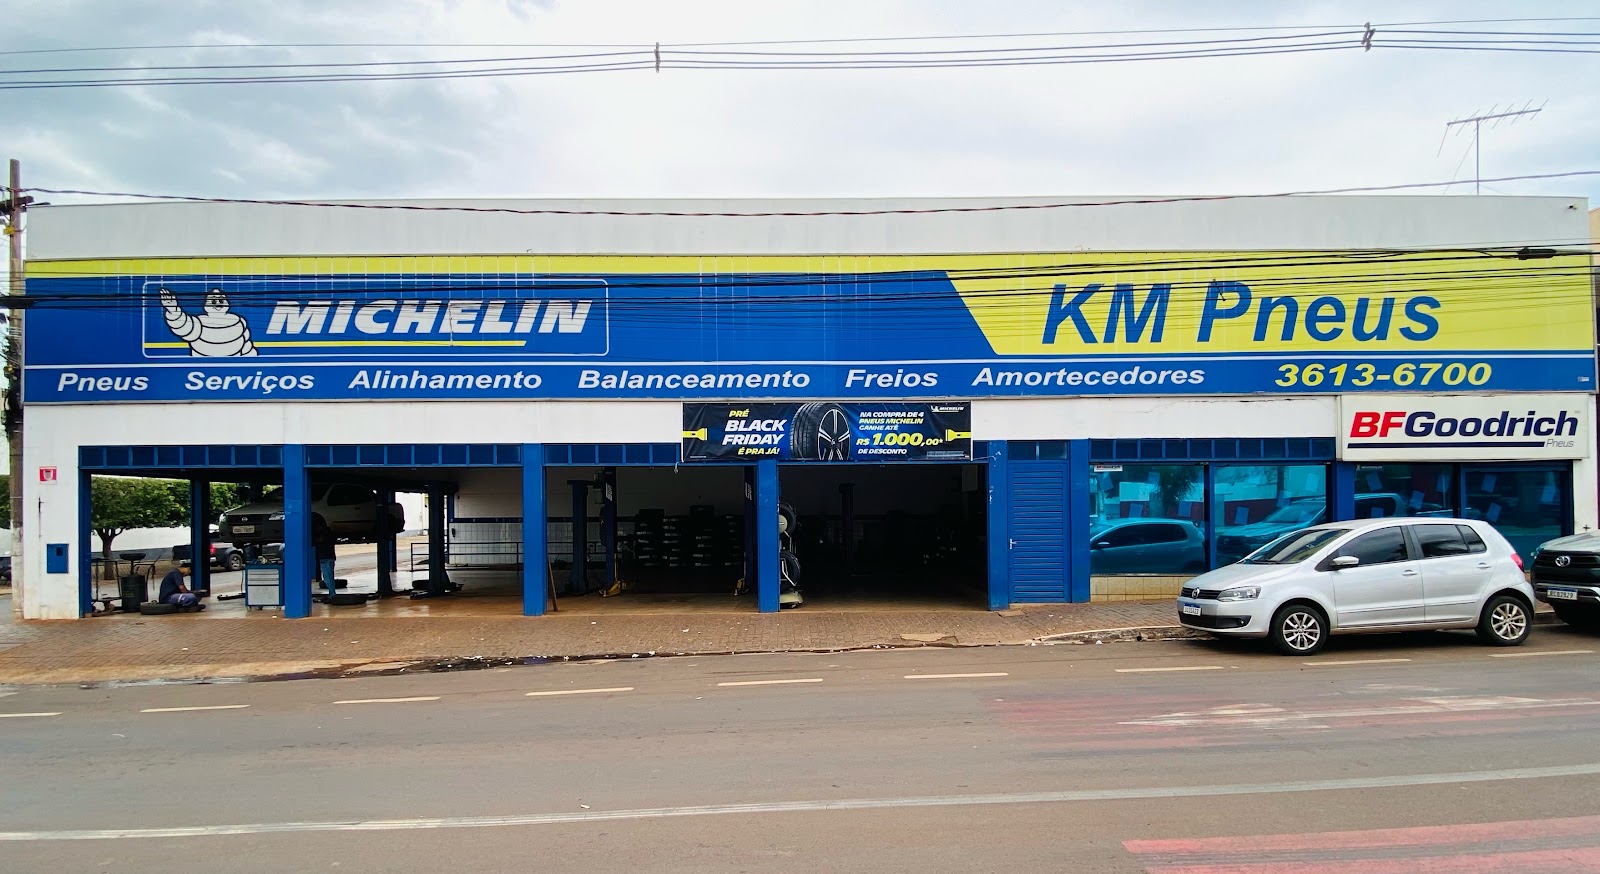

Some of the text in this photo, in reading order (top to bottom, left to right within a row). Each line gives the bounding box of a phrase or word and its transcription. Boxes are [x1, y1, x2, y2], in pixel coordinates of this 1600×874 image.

[266, 300, 592, 334] MICHELIN
[1042, 280, 1441, 344] KM Pneus
[57, 363, 1492, 394] Pneus Serviços Alinhamento Balanceamento Freios Amortecedores 3613-6700
[728, 408, 750, 417] PRÉ
[725, 419, 787, 431] BLACK
[1350, 410, 1578, 437] BFGoodrich
[722, 434, 785, 445] FRIDAY
[856, 438, 870, 446] R$
[1546, 439, 1574, 448] Pneus
[737, 447, 745, 455] É
[765, 446, 780, 455] JÁ!
